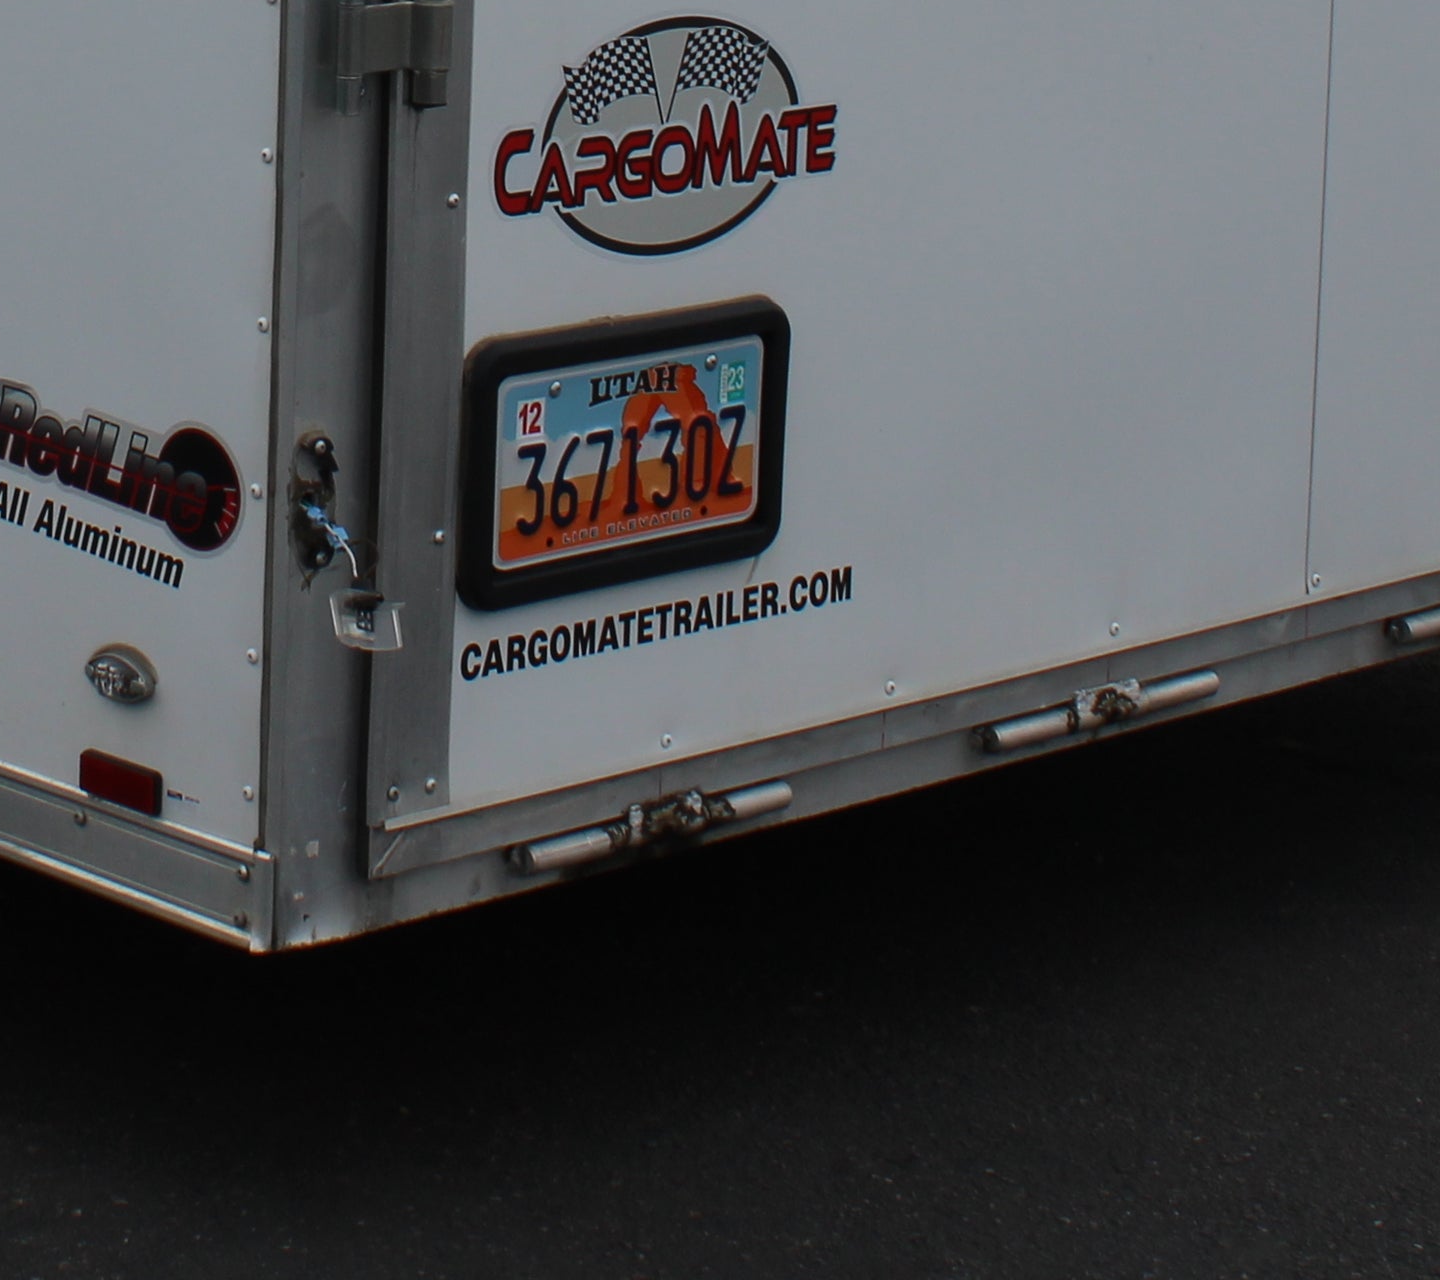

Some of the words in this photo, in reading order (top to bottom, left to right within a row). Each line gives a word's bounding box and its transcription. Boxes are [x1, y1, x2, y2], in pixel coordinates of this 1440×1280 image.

[589, 365, 678, 407] UTAH
[728, 365, 745, 391] 23
[518, 401, 543, 436] 12
[516, 404, 747, 536] 367130Z
[606, 507, 693, 536] ELEVATED
[32, 498, 185, 589] Aluminum
[460, 566, 853, 681] CARGOMATETRAILER.COM
